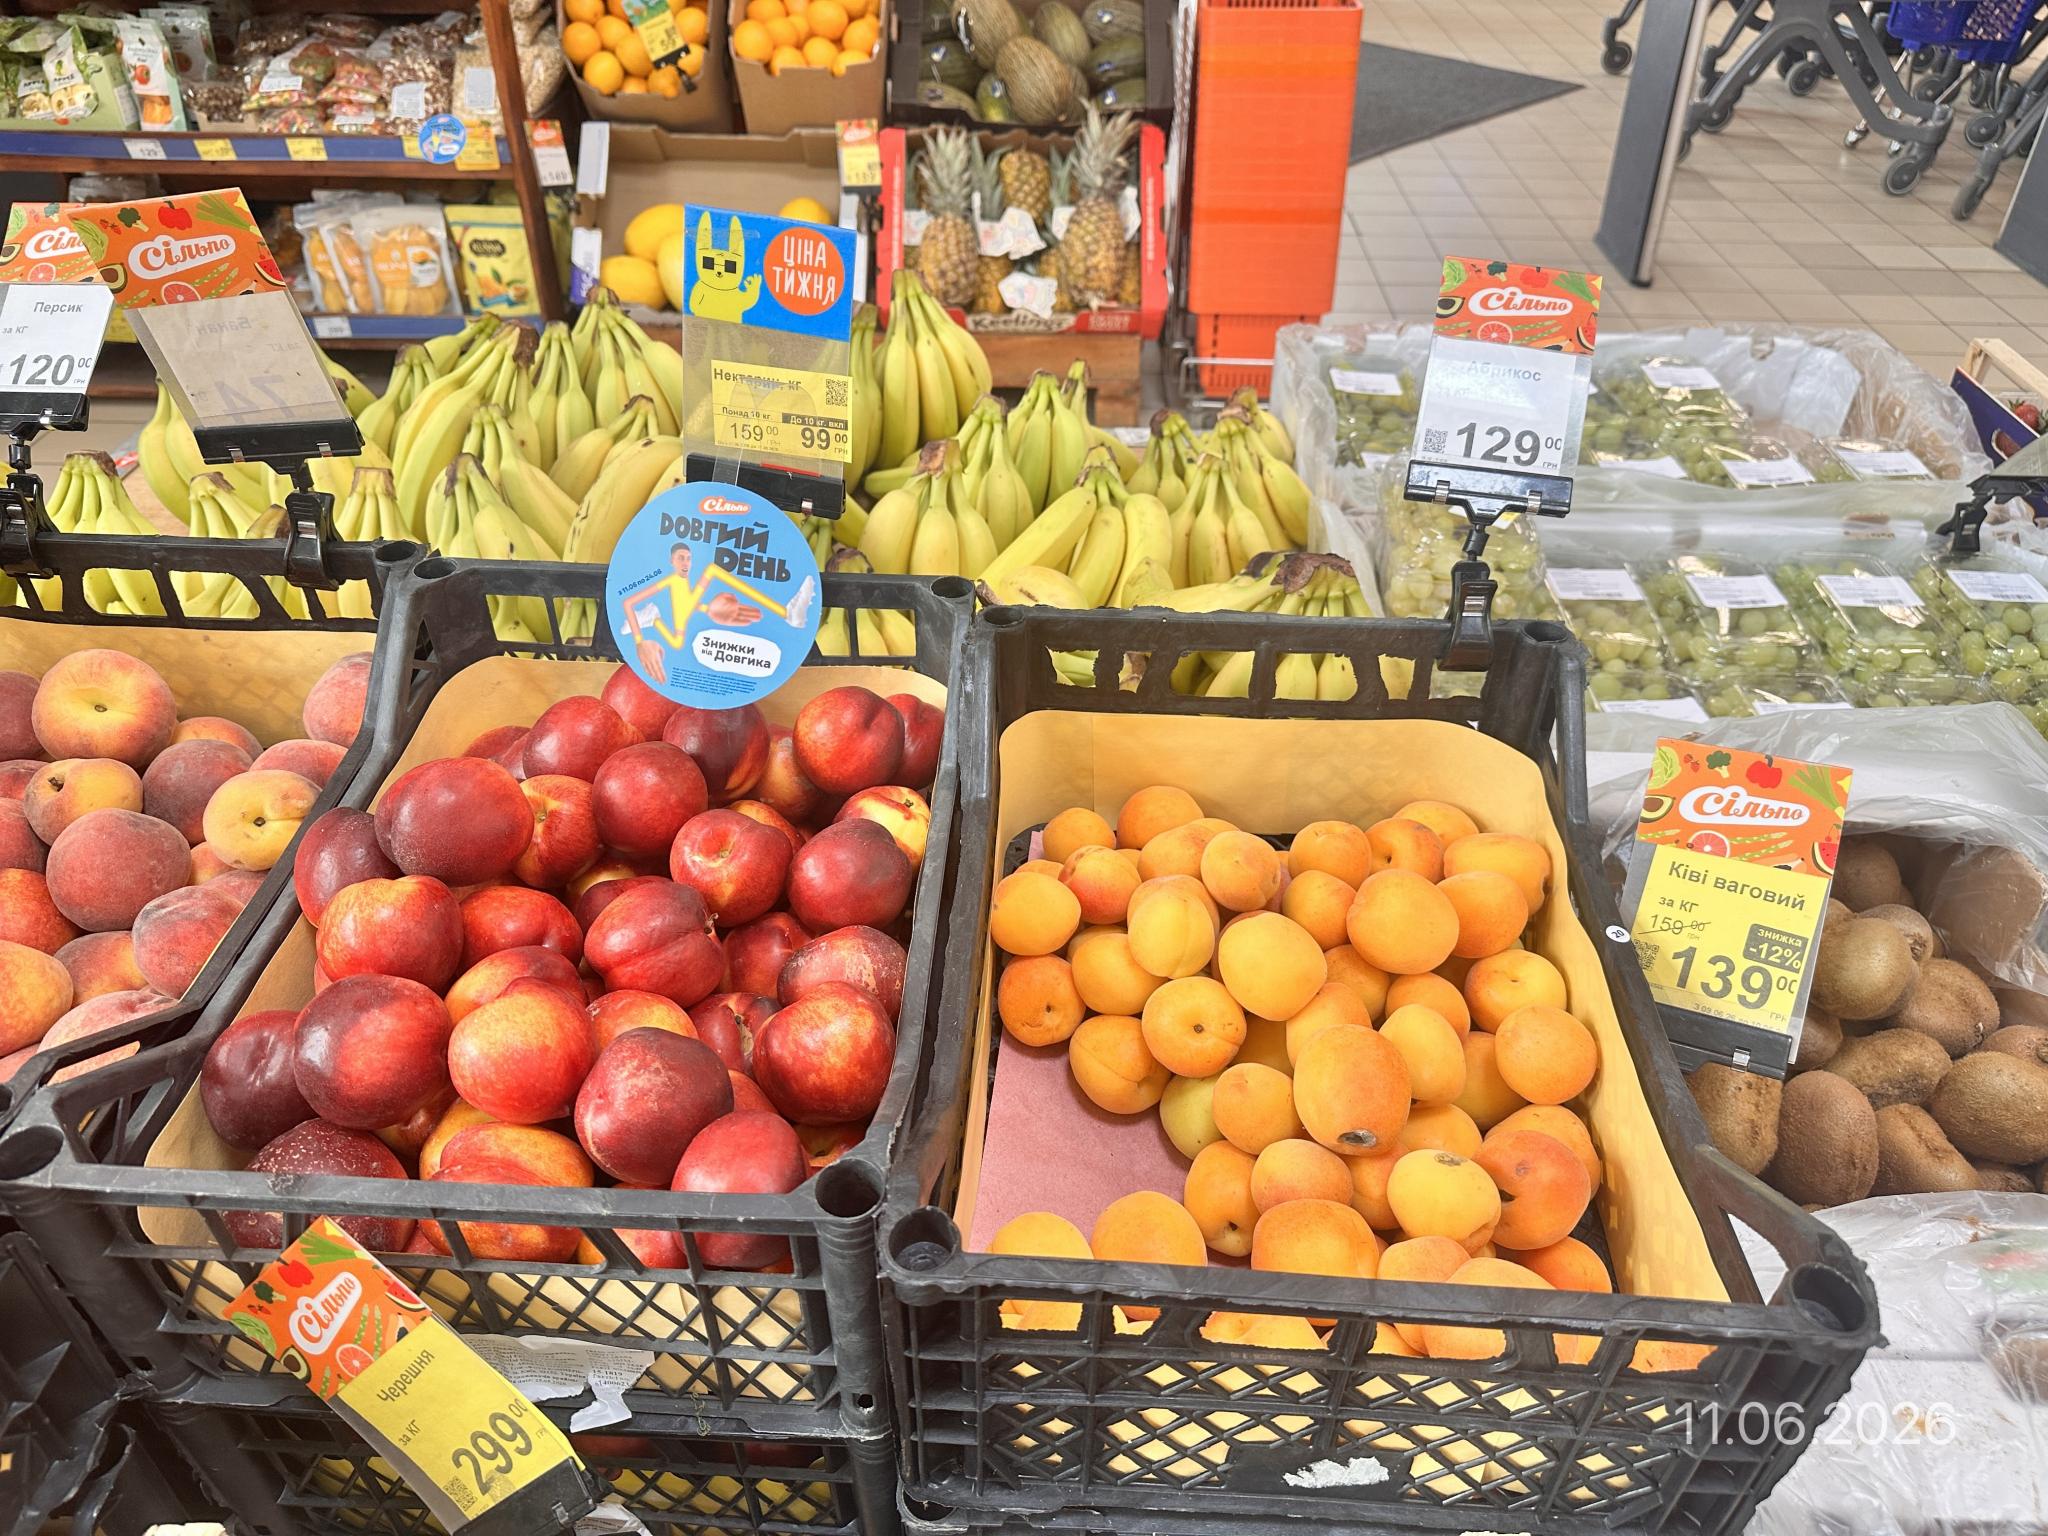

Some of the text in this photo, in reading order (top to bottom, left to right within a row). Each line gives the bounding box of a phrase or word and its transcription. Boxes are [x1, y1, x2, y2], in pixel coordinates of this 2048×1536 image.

[34, 231, 85, 253] Сіл
[783, 235, 827, 269] ЦІНА
[139, 240, 230, 272] Сільпо
[772, 266, 836, 306] ТИЖНЯ
[33, 301, 84, 316] Персик
[1479, 291, 1569, 313] Сільпо
[9, 353, 77, 387] 120
[722, 406, 749, 419] Понад
[790, 415, 802, 425] До
[804, 416, 814, 425] 10
[730, 422, 779, 442] 159 00
[800, 426, 831, 451] 99
[834, 433, 848, 444] 00
[1456, 421, 1541, 467] 129
[703, 496, 749, 513] Сільпо
[702, 636, 755, 656] Знижки
[713, 650, 771, 670] Довгика
[1693, 790, 1803, 820] Сільпо
[1668, 860, 1806, 912] Ківі ваговий
[1658, 896, 1699, 914] за КГ
[1611, 929, 1625, 940] 20
[1651, 913, 1683, 935] 159
[1749, 942, 1802, 970] -12%
[1671, 945, 1773, 1010] 139
[297, 1279, 356, 1343] Сільпо
[376, 1348, 435, 1404] Черешня
[398, 1418, 426, 1446] за КГ
[451, 1411, 533, 1496] 299
